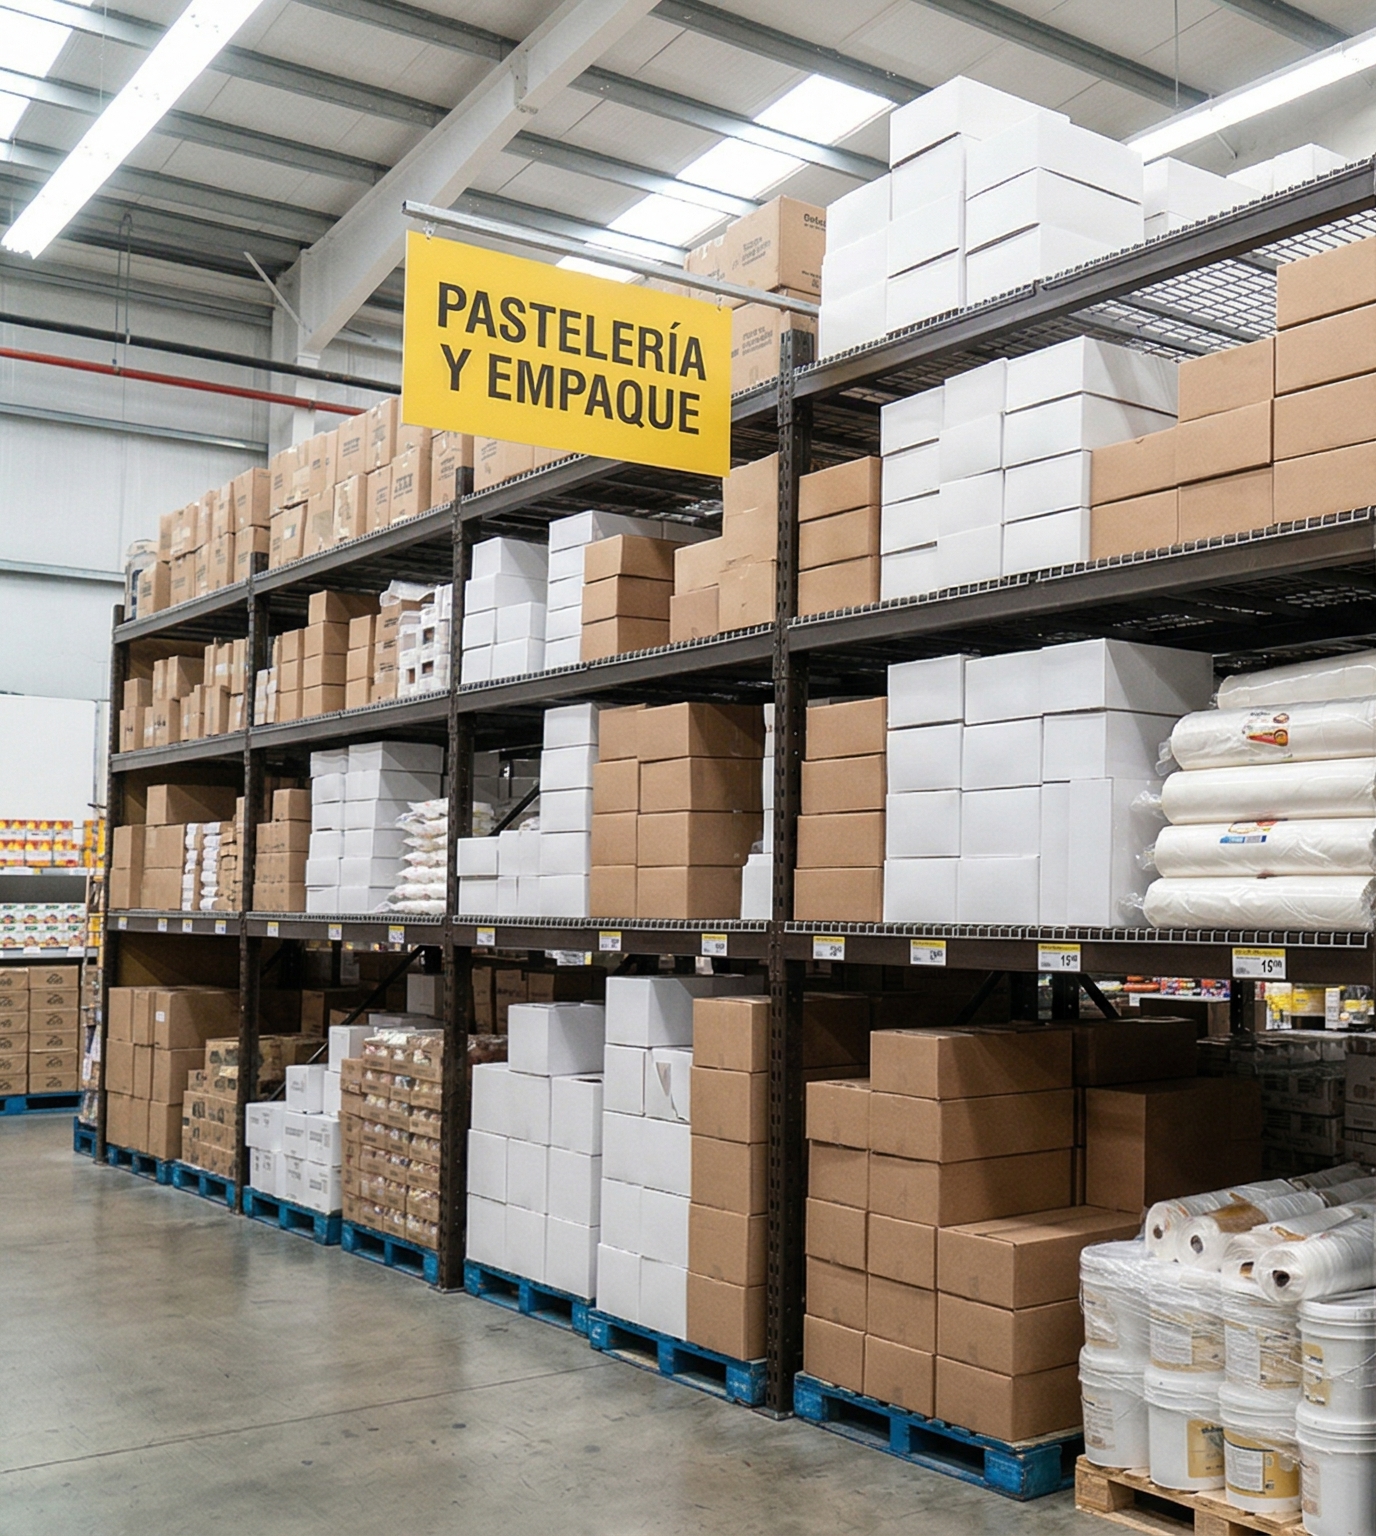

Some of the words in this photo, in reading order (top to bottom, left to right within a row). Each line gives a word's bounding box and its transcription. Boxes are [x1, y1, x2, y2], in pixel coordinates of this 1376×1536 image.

[437, 281, 707, 382] PASTELERÍA
[440, 343, 472, 392] Y
[487, 352, 701, 436] EMPAQUE
